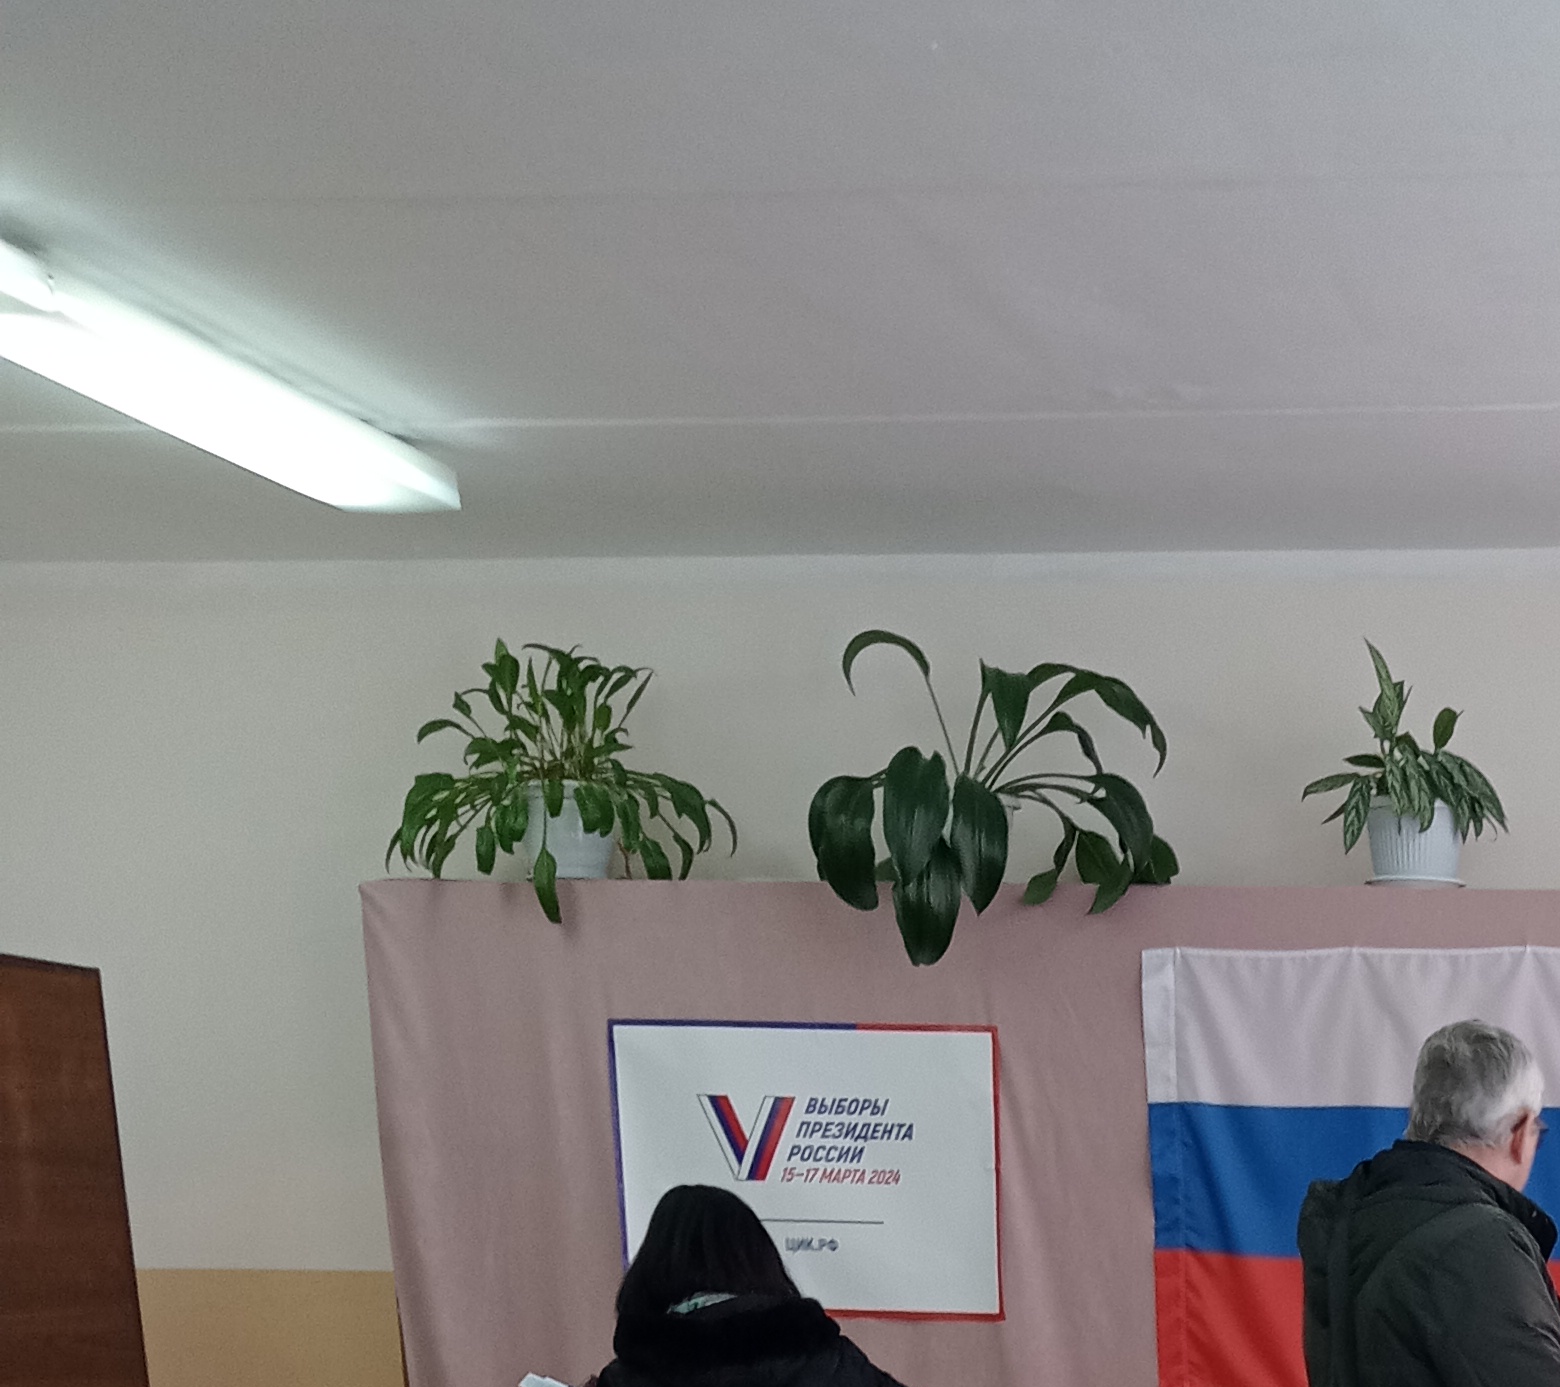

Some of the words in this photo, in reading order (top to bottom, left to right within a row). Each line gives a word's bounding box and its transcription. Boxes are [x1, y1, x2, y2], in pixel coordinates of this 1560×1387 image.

[805, 1098, 889, 1116] ВЫБОРЫ
[796, 1121, 914, 1141] ПРЕЗИДЕНТА
[787, 1145, 865, 1163] РОССИИ
[819, 1169, 866, 1185] МАРТА
[868, 1170, 901, 1186] 2024
